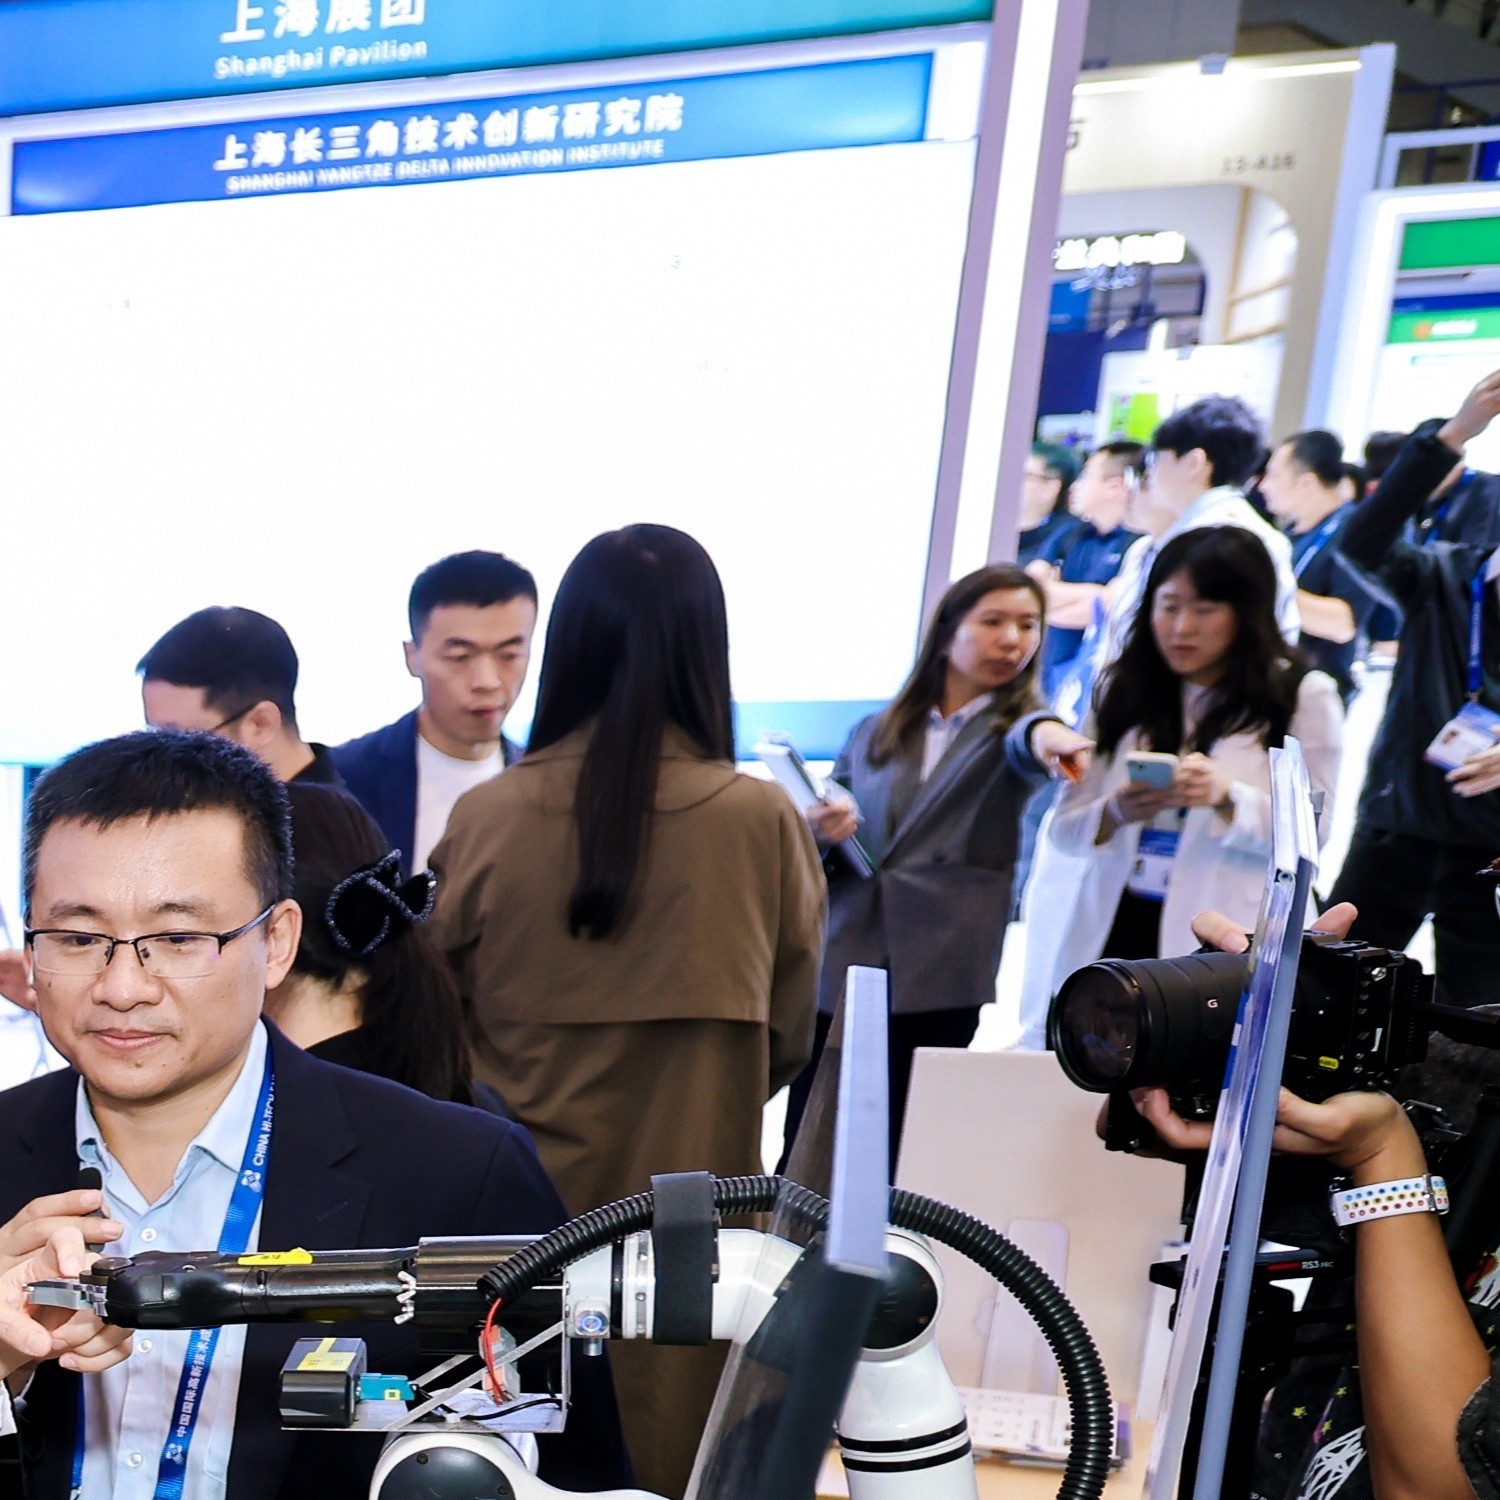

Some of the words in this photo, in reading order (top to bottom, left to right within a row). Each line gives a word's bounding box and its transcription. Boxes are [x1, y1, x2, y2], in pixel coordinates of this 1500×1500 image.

[219, 0, 425, 44] 上海展团
[214, 47, 324, 79] Shanghai
[329, 39, 428, 68] Pavilion
[212, 93, 684, 172] 上海长三角技术创新研究院
[225, 169, 314, 194] SHANGHAI
[315, 162, 394, 187] YANGTZE
[395, 157, 450, 180] DELTA
[453, 147, 564, 175] INNOVATION
[566, 138, 666, 165] INSTITUTE
[252, 1133, 272, 1167] CHINA
